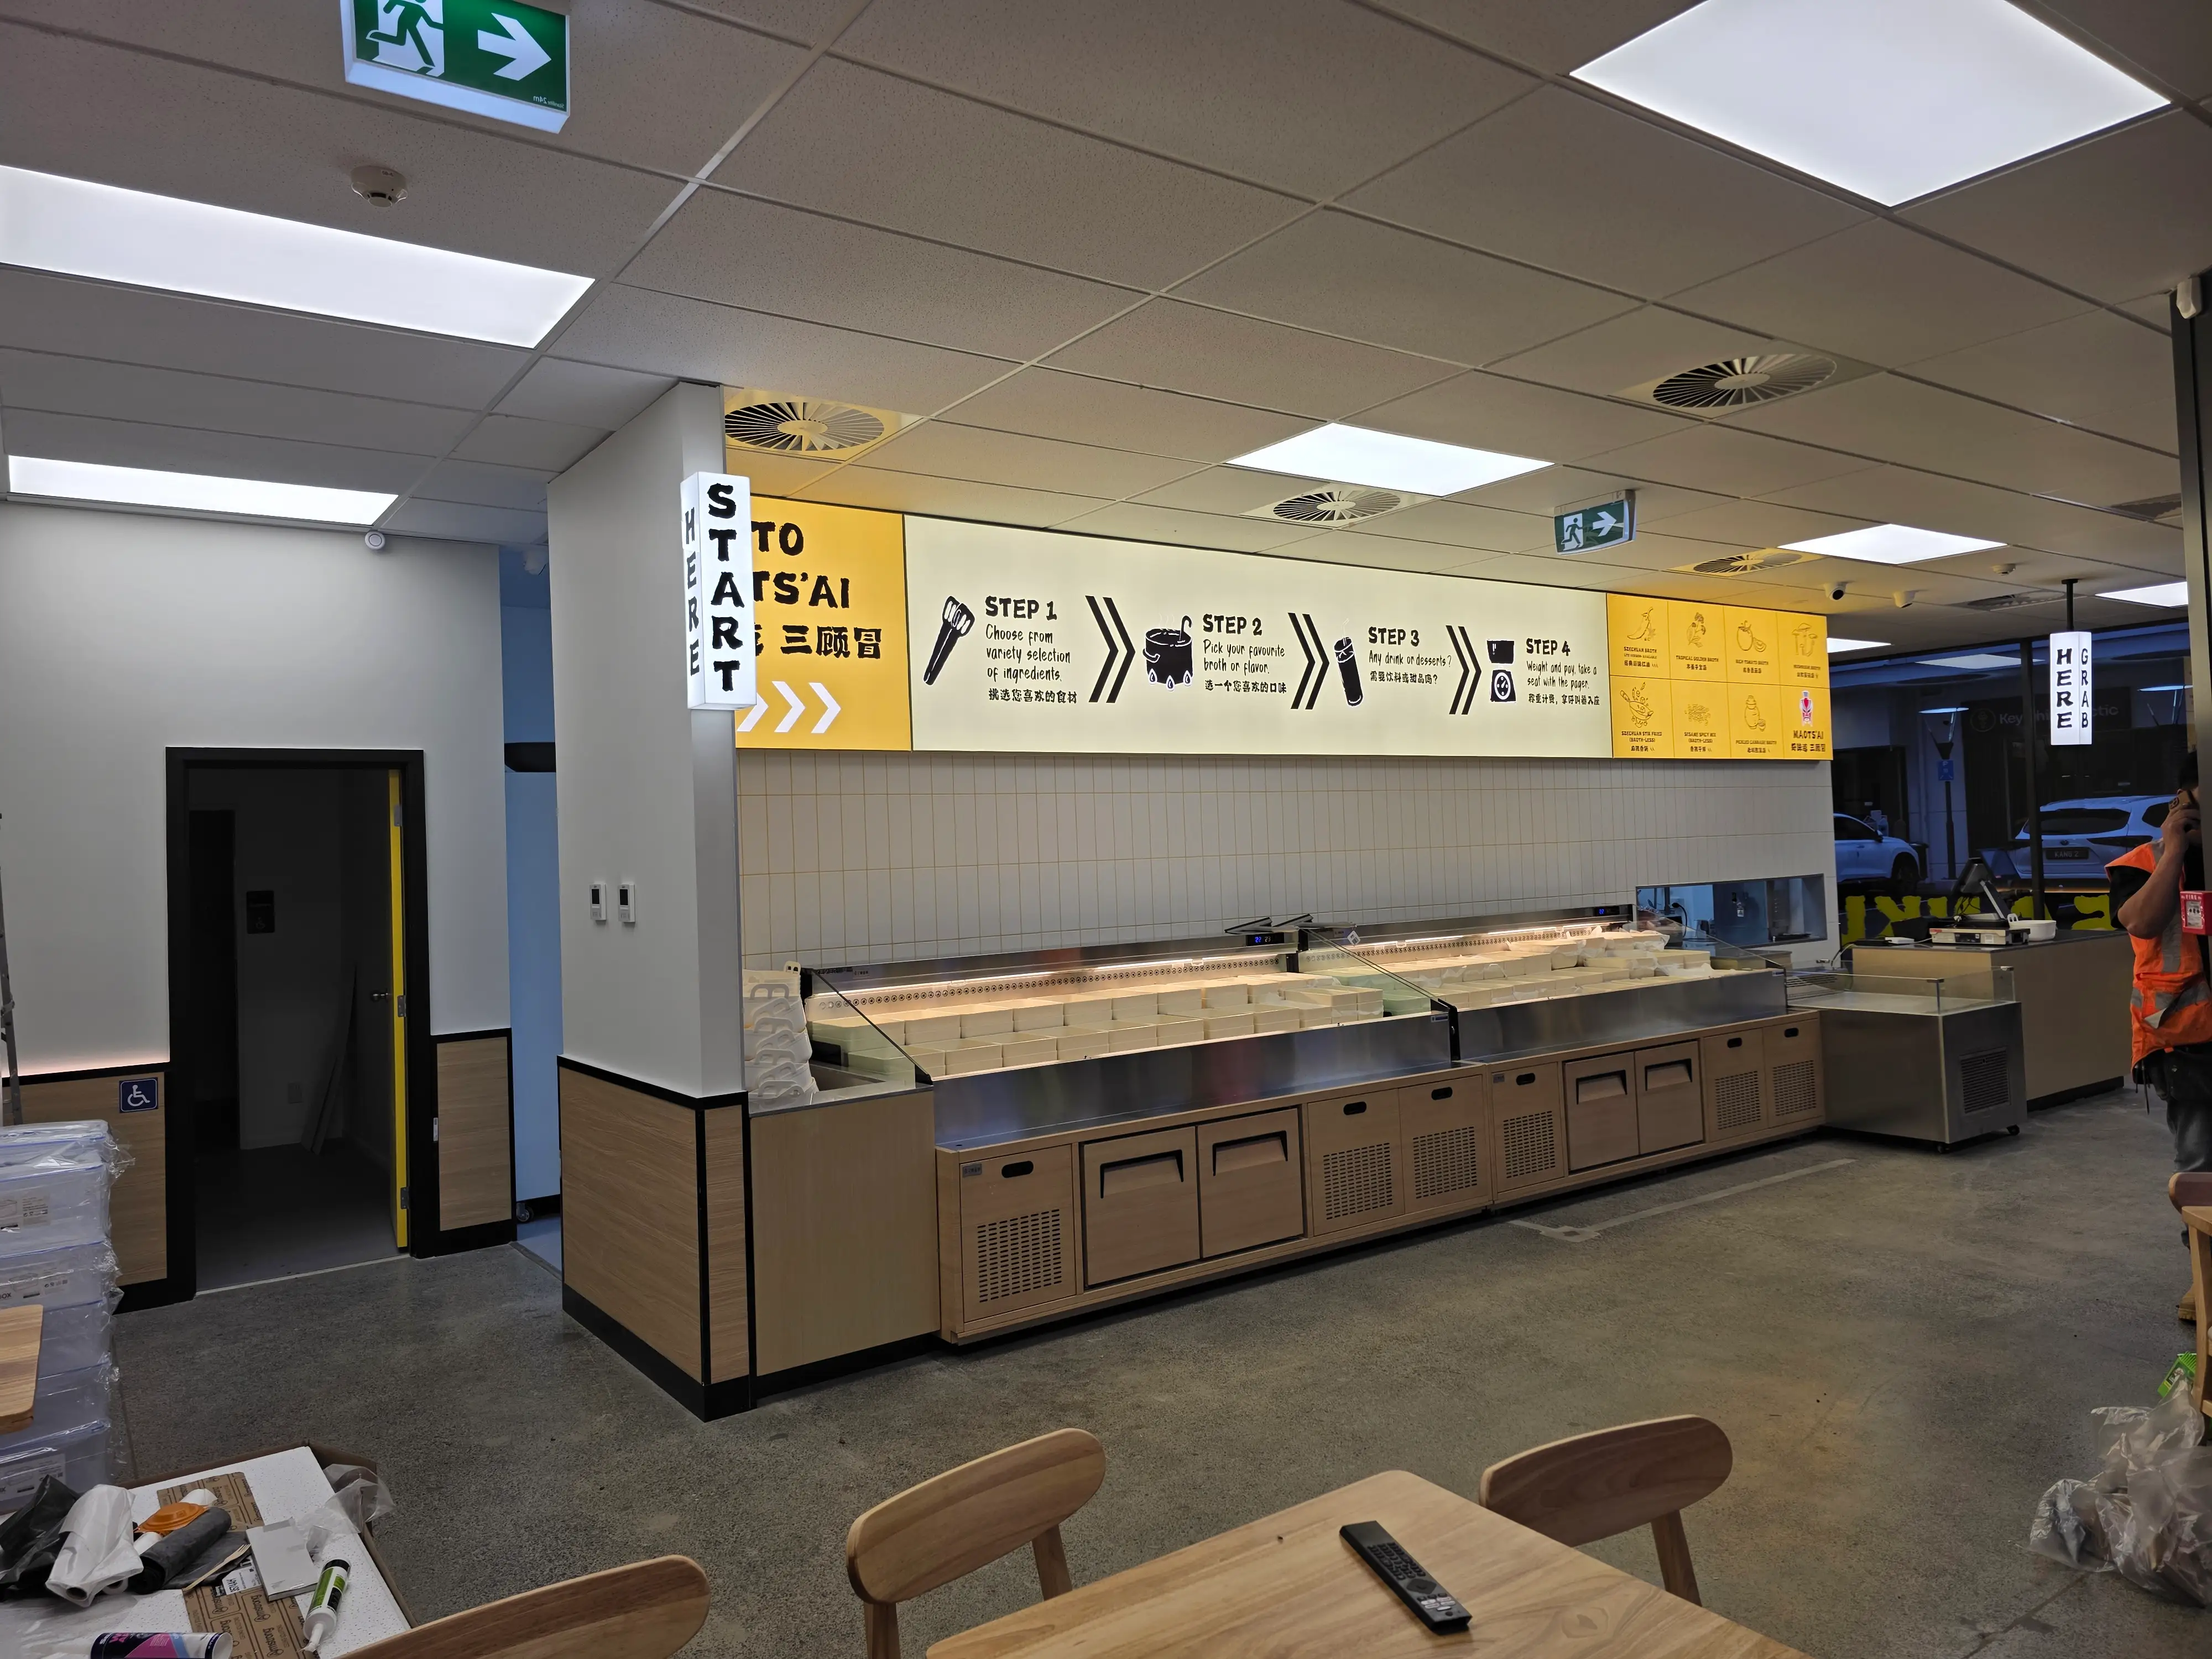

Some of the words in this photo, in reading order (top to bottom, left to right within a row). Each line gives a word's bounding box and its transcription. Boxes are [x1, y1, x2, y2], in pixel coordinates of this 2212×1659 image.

[752, 521, 804, 556] TO
[685, 508, 700, 676] HERE
[707, 483, 744, 691] START
[985, 596, 1039, 619] STEP
[1046, 601, 1057, 620] 1
[1203, 614, 1246, 634] STEP
[1253, 618, 1262, 635] 2
[986, 624, 1023, 640] Choose
[1029, 632, 1052, 646] from
[1369, 627, 1406, 645] STEP
[1411, 630, 1419, 646] 3
[987, 646, 1021, 664] variety
[1027, 648, 1070, 663] selection
[1203, 639, 1223, 654] Pick
[1227, 644, 1245, 657] your
[1249, 645, 1285, 659] favourite
[1526, 638, 1557, 655] STEP
[1562, 641, 1571, 656] 4
[1204, 656, 1229, 671] broth
[1231, 662, 1239, 671] or
[1244, 658, 1269, 676] flavor.
[1369, 650, 1381, 666] Any
[1385, 652, 1403, 665] drink
[1407, 656, 1415, 665] or
[1527, 661, 1548, 675] Weight
[1551, 662, 1561, 673] and
[1578, 663, 1590, 675] take
[1593, 666, 1597, 675] a
[988, 667, 998, 681] of
[1004, 663, 1062, 684] ingredients.
[1370, 671, 1438, 684] 需要饮料或甜品吗?
[1527, 676, 1541, 686] seat
[1543, 676, 1556, 687] with
[1558, 676, 1568, 687] the
[1571, 680, 1589, 691] pager.
[989, 688, 1077, 703] 挑选您喜欢的食材
[1206, 680, 1286, 693] 选一个您喜欢的口味
[2057, 648, 2074, 728] HERE
[2000, 713, 2022, 726] Key
[251, 1594, 270, 1623] Armstrong
[263, 1627, 284, 1658] Armstrong
